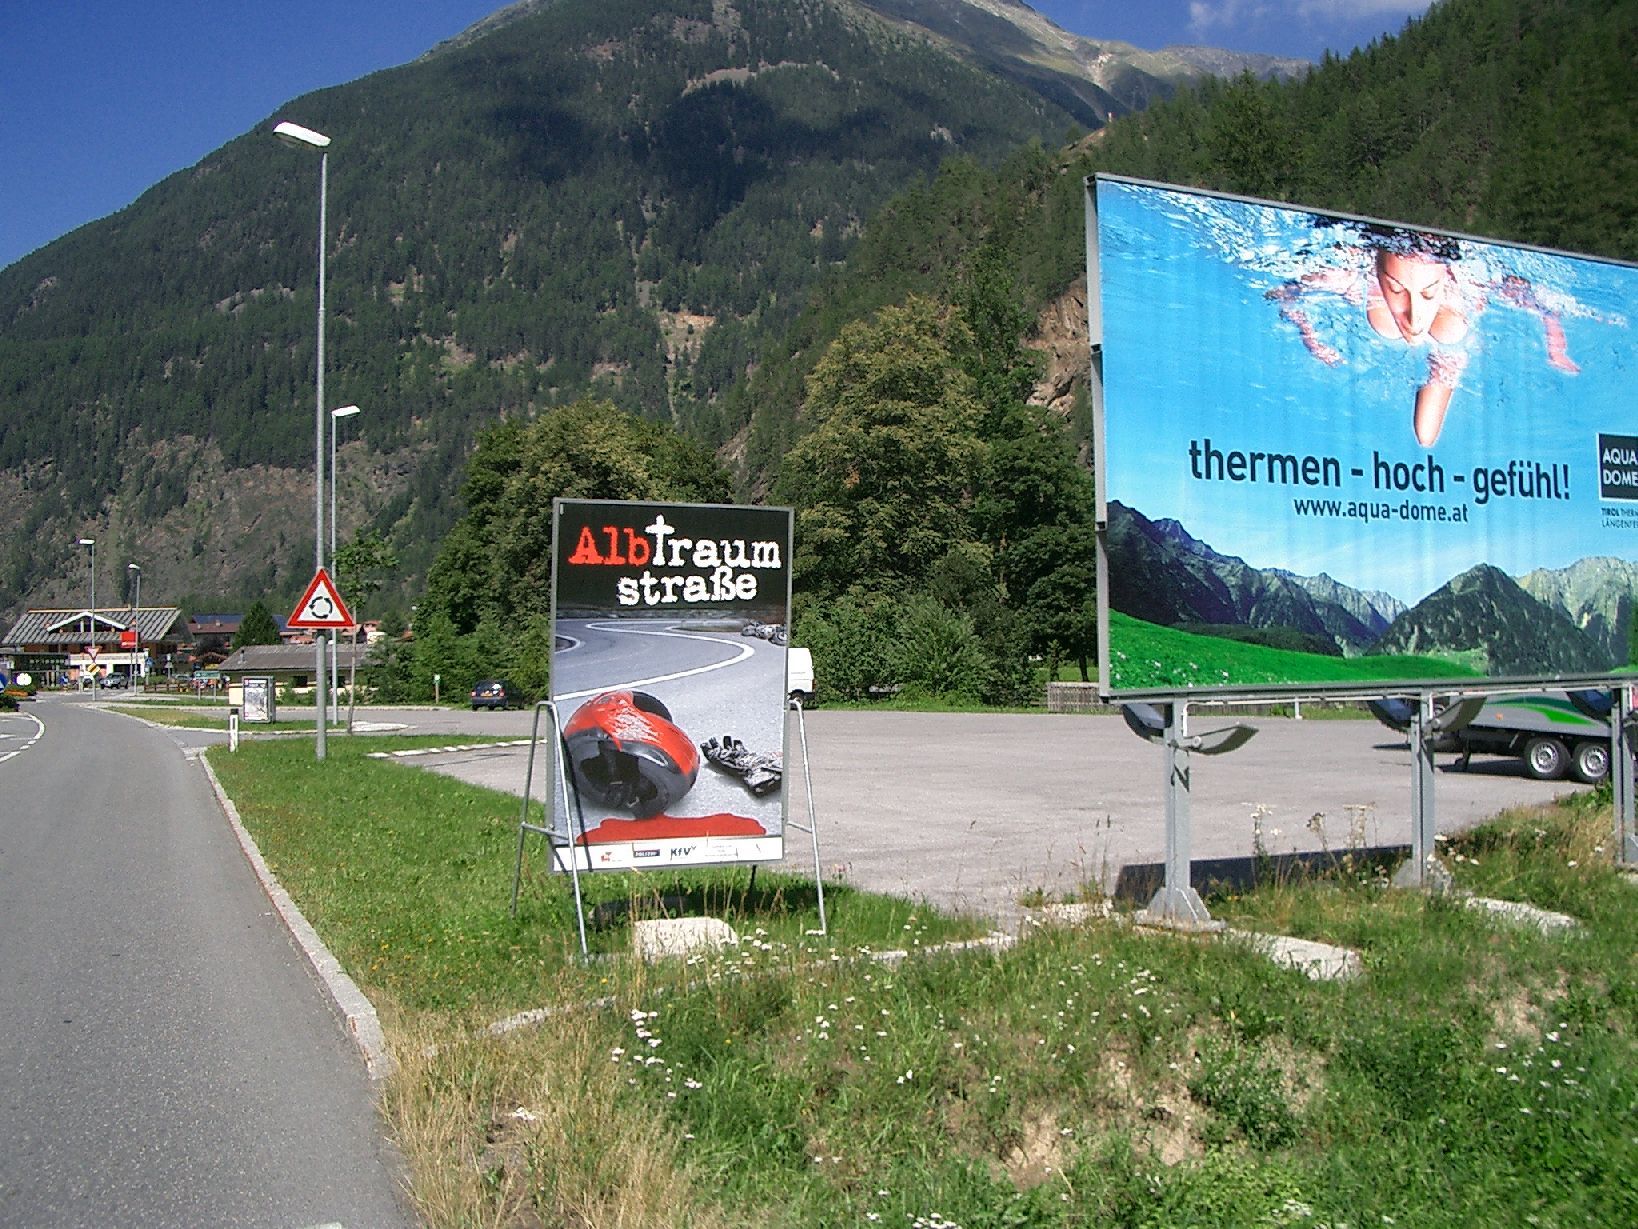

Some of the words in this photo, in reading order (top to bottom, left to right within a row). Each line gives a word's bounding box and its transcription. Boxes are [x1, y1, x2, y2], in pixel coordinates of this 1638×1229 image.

[1188, 438, 1341, 487] thermen
[1373, 451, 1445, 493] hoch
[1473, 460, 1570, 505] gefühl!
[1602, 447, 1638, 465] AQUA
[1602, 468, 1638, 487] DOME
[1294, 499, 1468, 523] www.aqua-dome.at
[568, 513, 781, 569] Albtraum
[616, 565, 757, 606] straße
